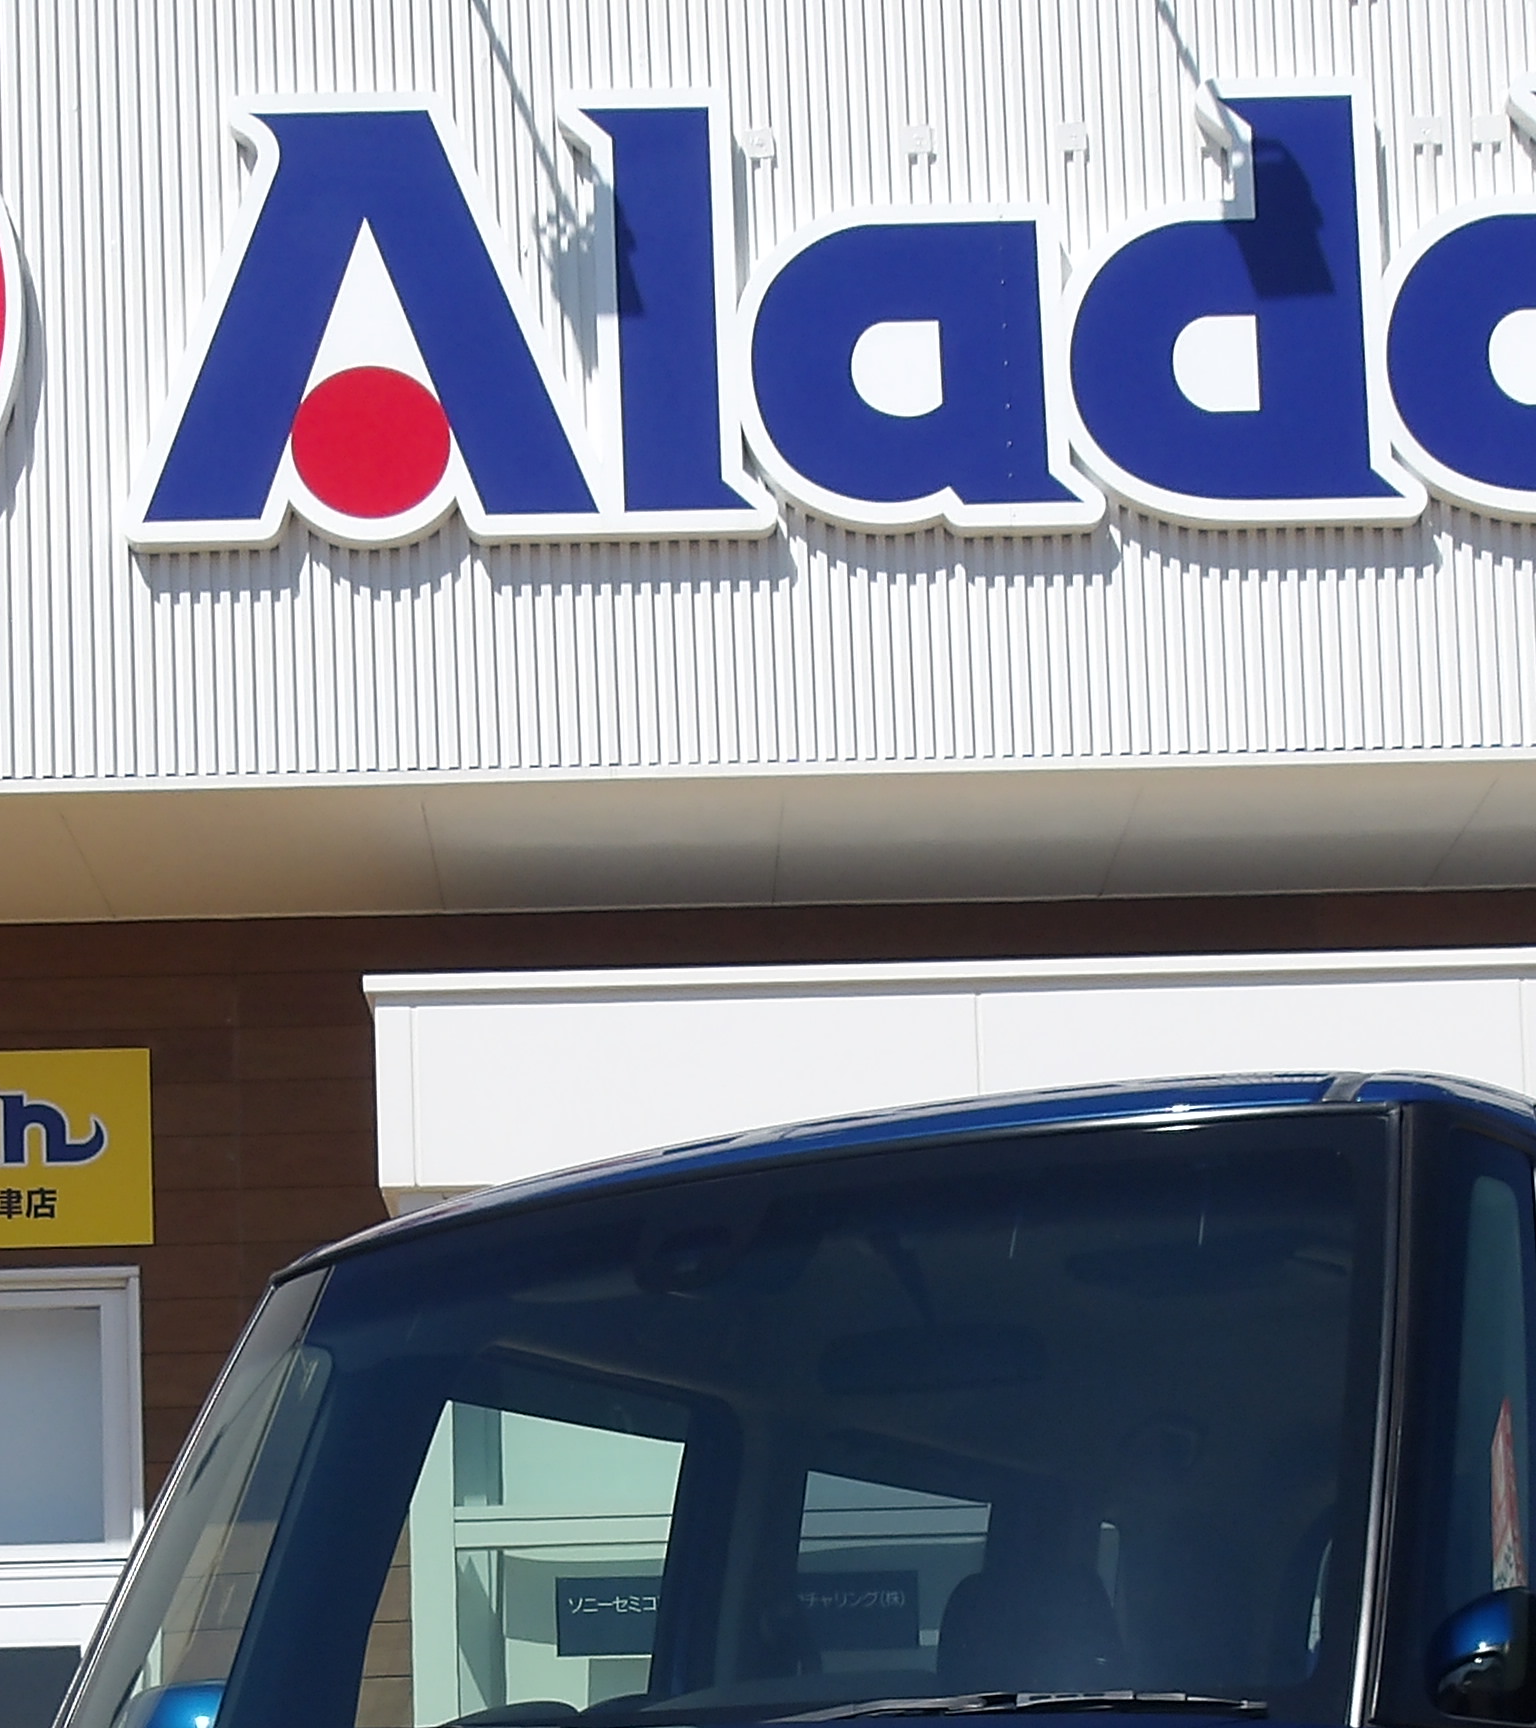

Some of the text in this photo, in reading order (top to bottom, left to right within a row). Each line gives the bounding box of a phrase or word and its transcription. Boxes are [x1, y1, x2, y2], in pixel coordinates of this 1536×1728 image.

[567, 1595, 660, 1614] ソニーセミコ
